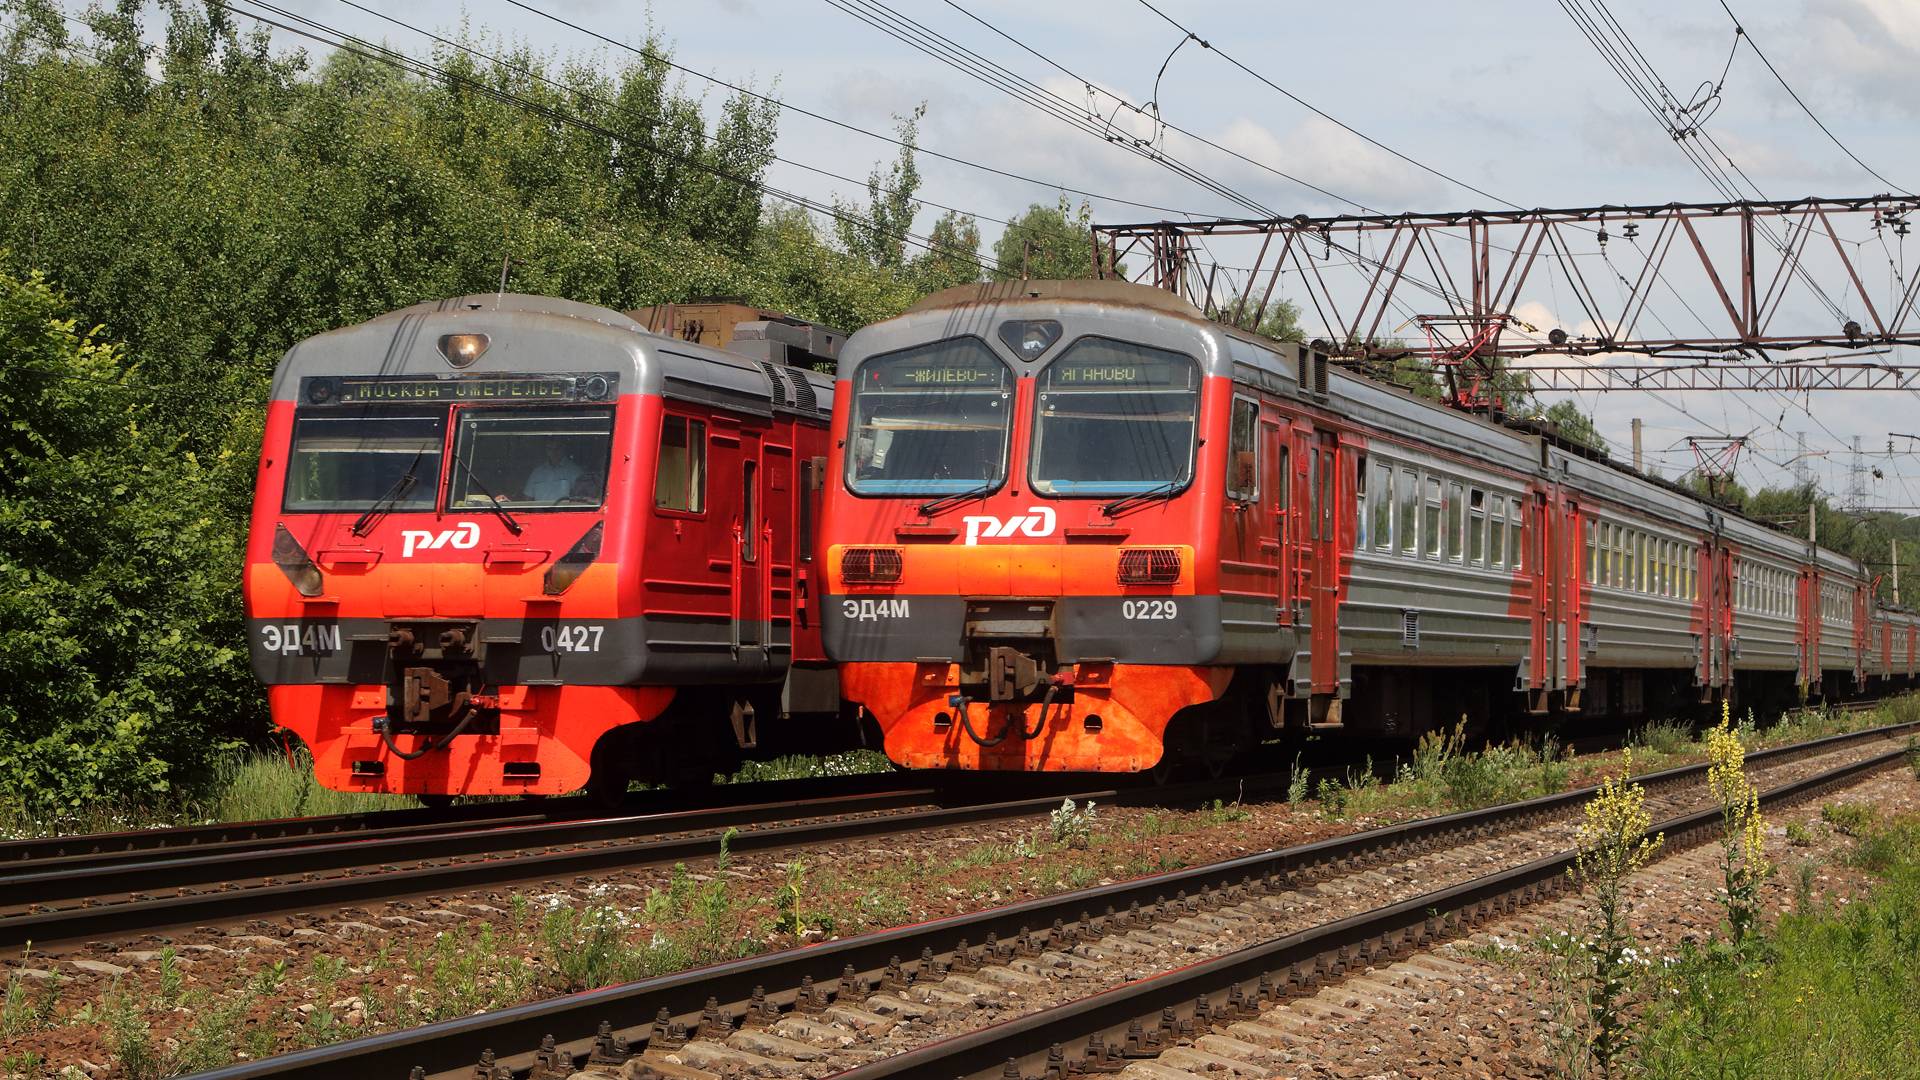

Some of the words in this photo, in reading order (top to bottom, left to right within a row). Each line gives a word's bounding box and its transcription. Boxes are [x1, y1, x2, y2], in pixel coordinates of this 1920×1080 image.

[842, 599, 910, 621] ЭД4М
[1122, 600, 1178, 621] 0229
[261, 624, 341, 656] ЭД4М
[541, 625, 605, 653] 0427
